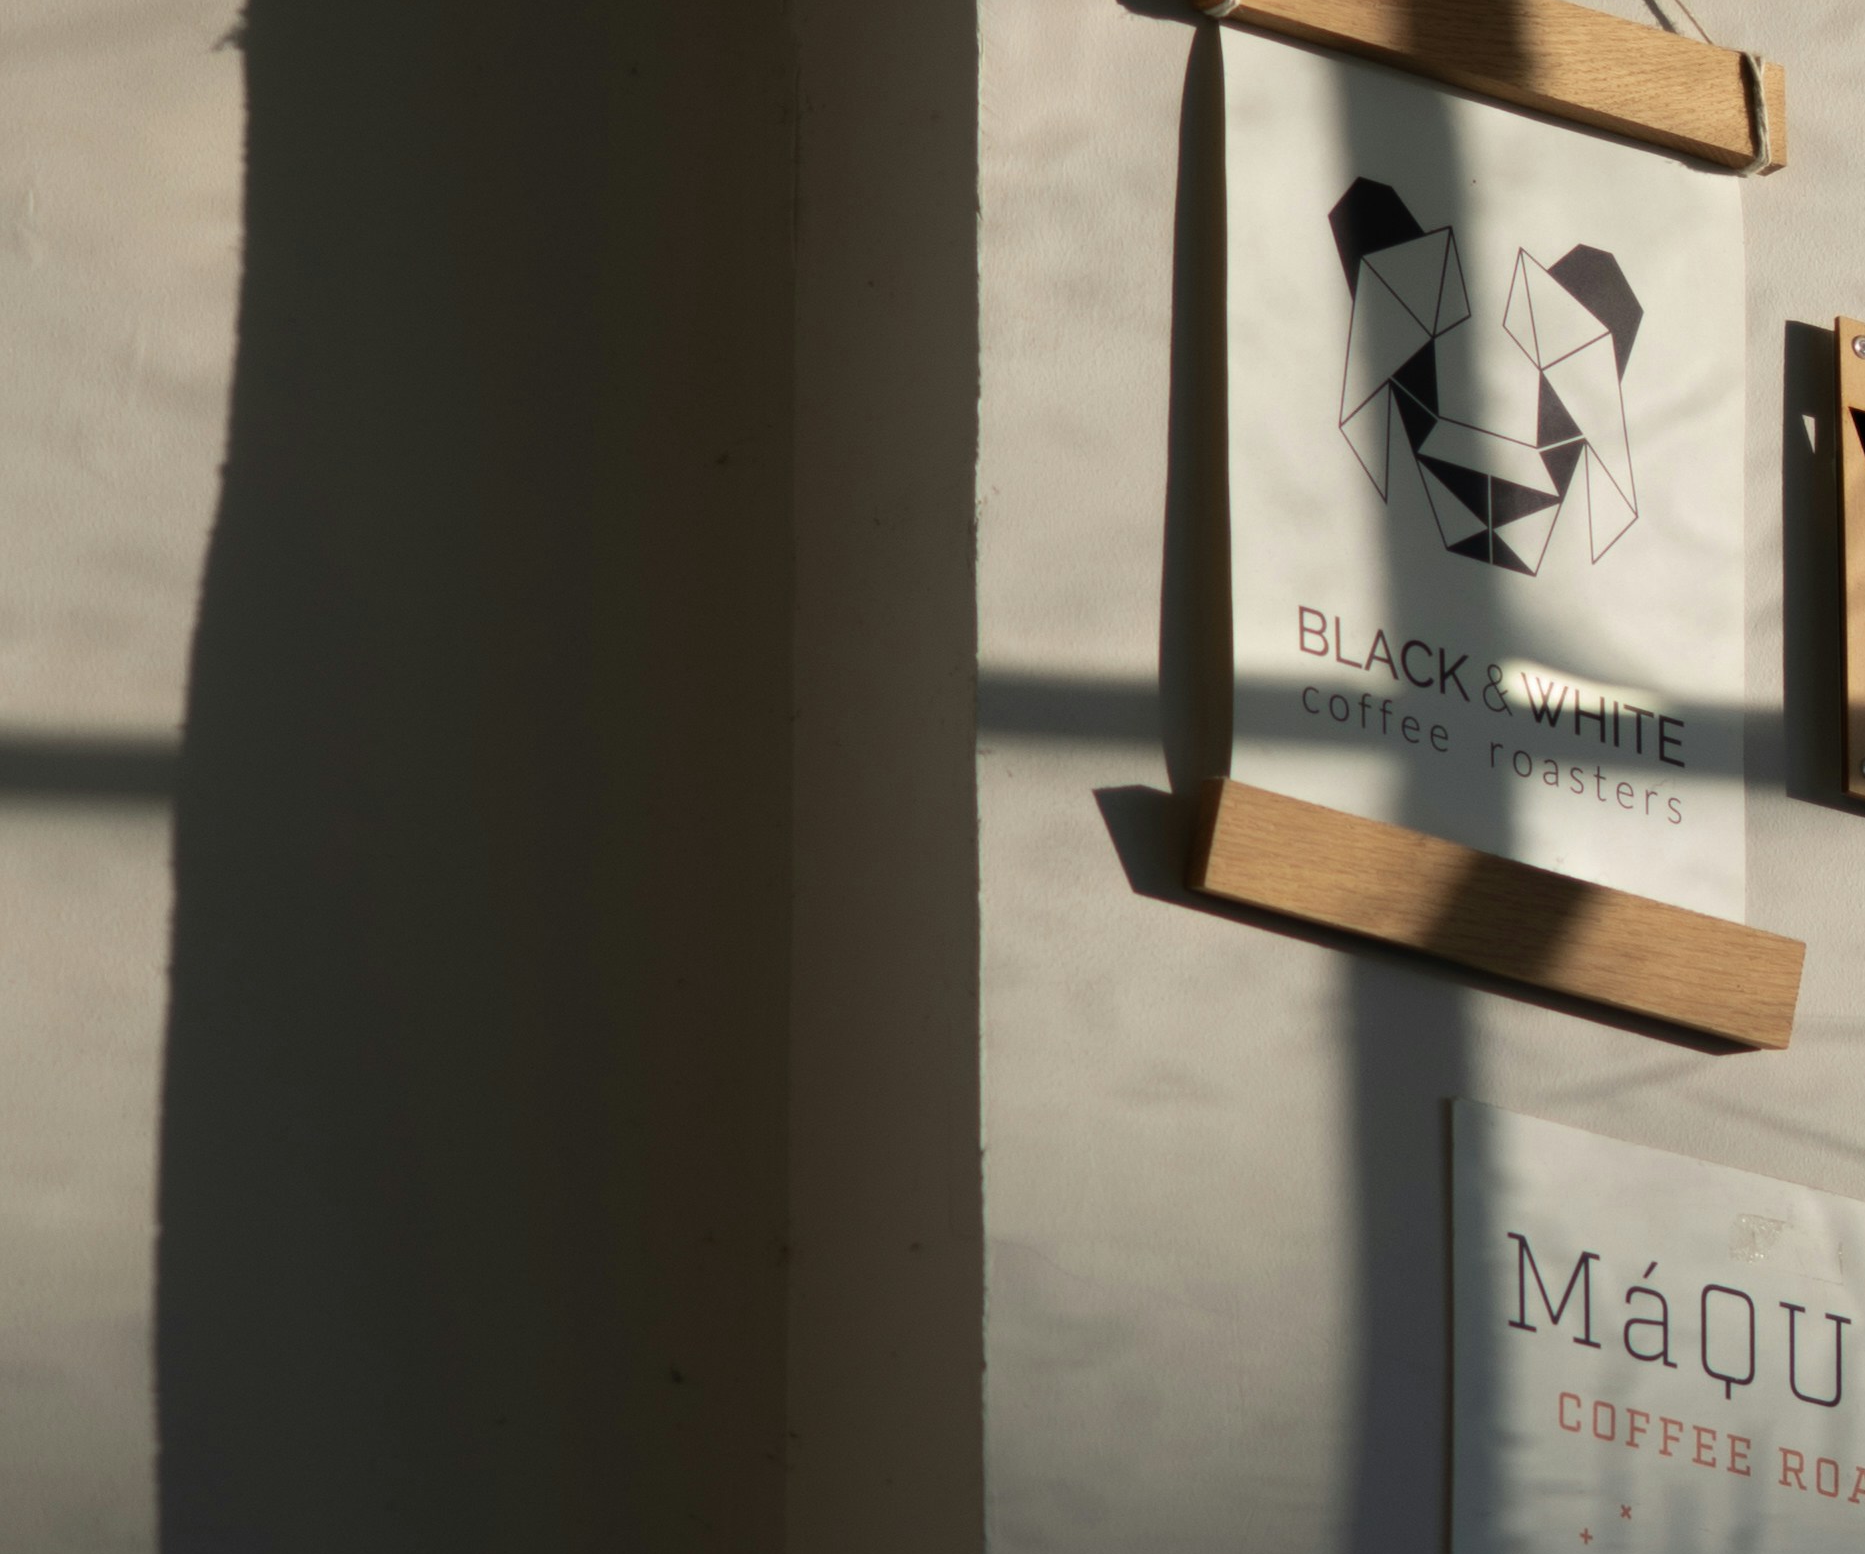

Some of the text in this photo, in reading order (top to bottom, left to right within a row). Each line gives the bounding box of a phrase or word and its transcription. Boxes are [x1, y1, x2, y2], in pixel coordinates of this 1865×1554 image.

[1298, 605, 1470, 703] BLACK
[1520, 671, 1686, 768] WHITE
[1301, 679, 1684, 826] coffee roasters
[1558, 1391, 1752, 1478] COFFEE
